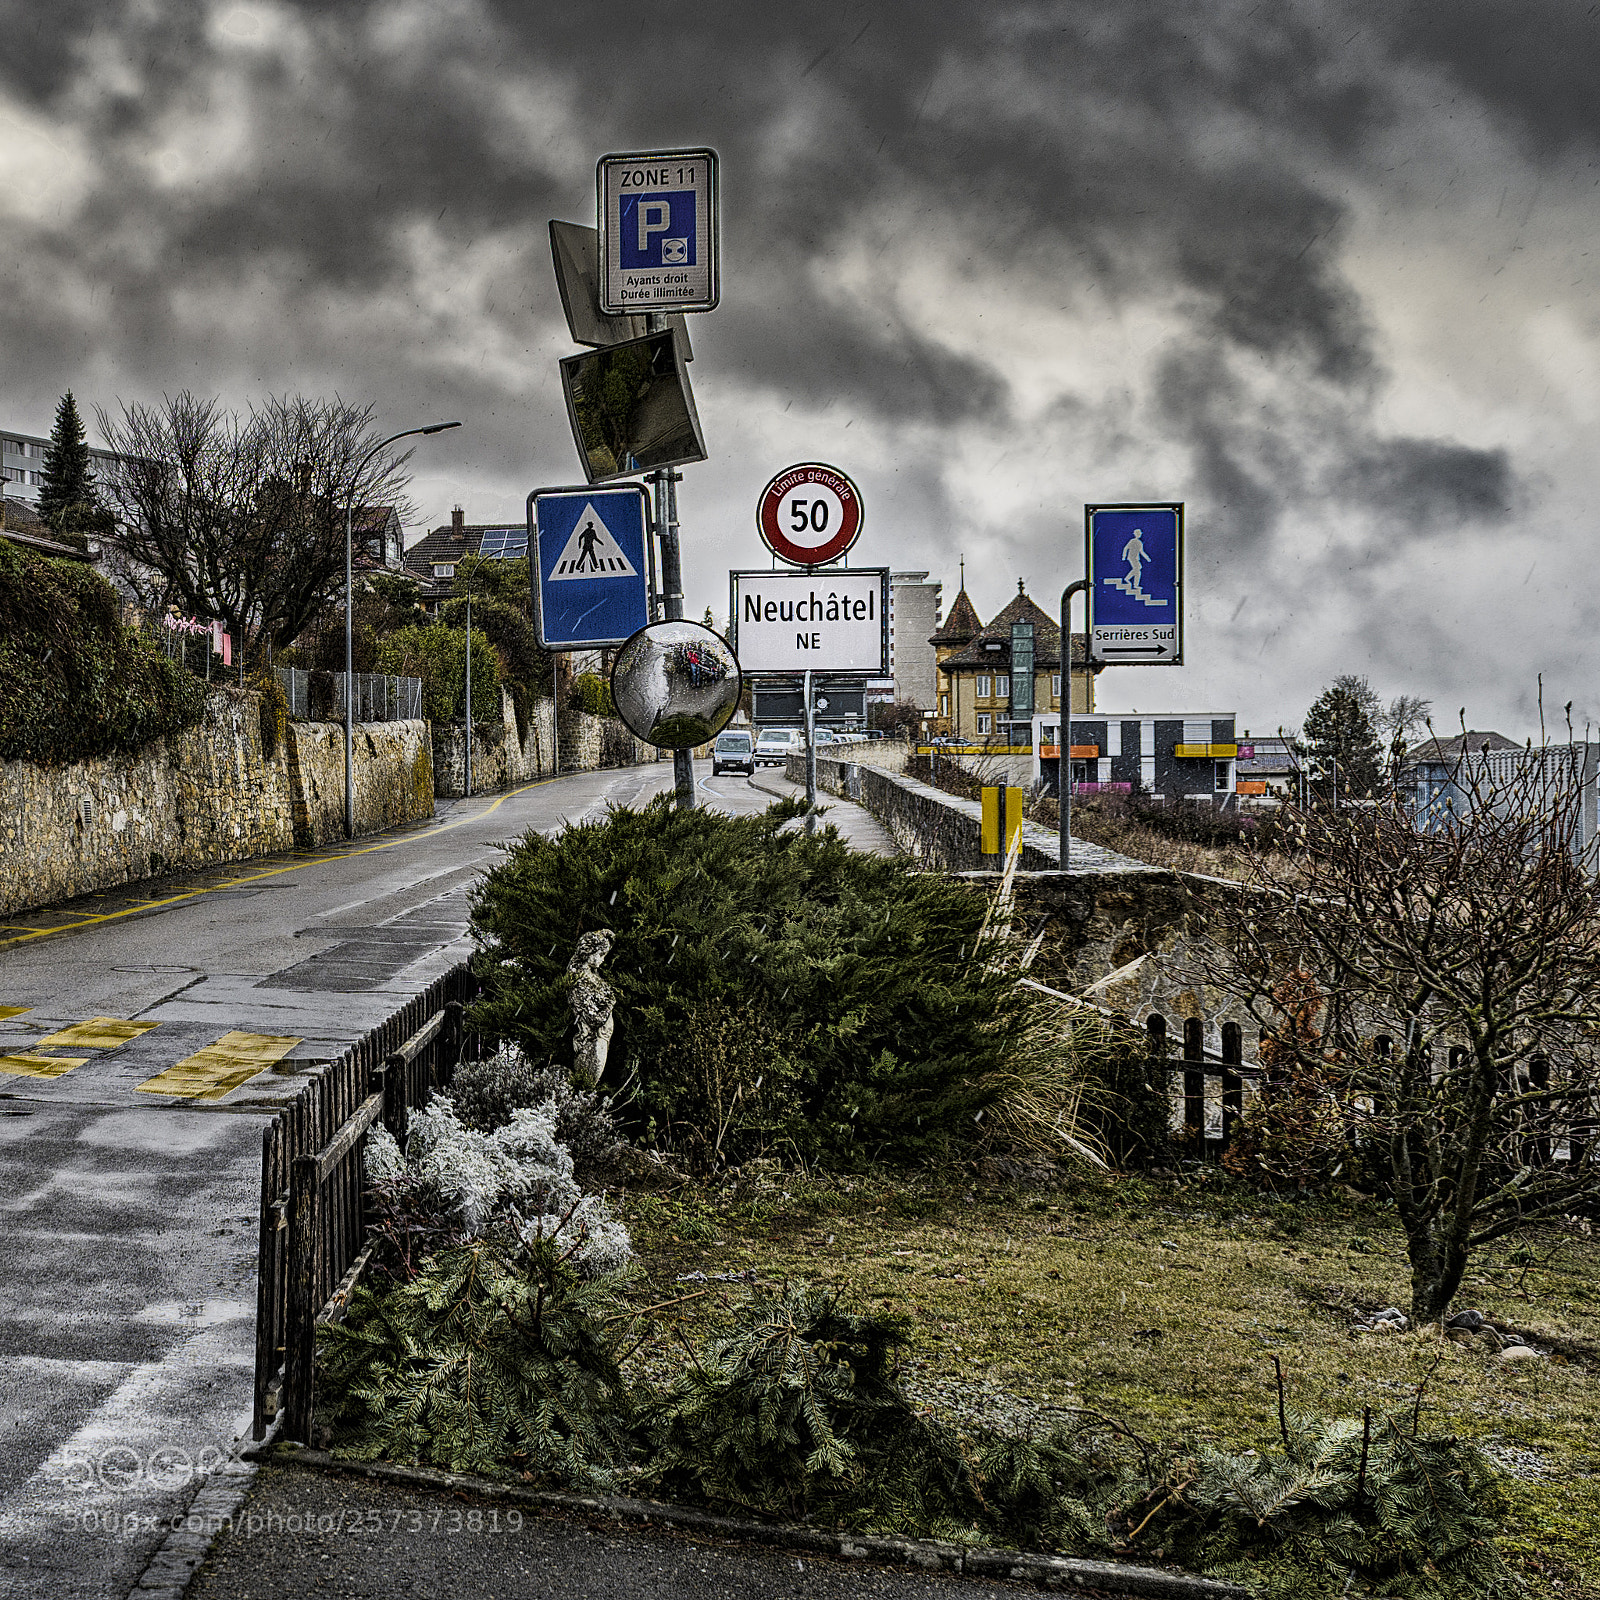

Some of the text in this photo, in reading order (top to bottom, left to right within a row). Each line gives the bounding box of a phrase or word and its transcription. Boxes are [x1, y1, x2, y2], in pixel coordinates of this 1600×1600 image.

[621, 167, 695, 187] ZONE 11
[638, 200, 670, 250] P
[626, 273, 688, 288] Ayants droit
[620, 286, 695, 299] Durée illimitée
[771, 469, 851, 501] Limite générale
[791, 499, 829, 532] 50
[744, 590, 874, 622] Neuchâtel
[796, 632, 821, 649] NE
[1095, 628, 1175, 640] Serrières Sud
